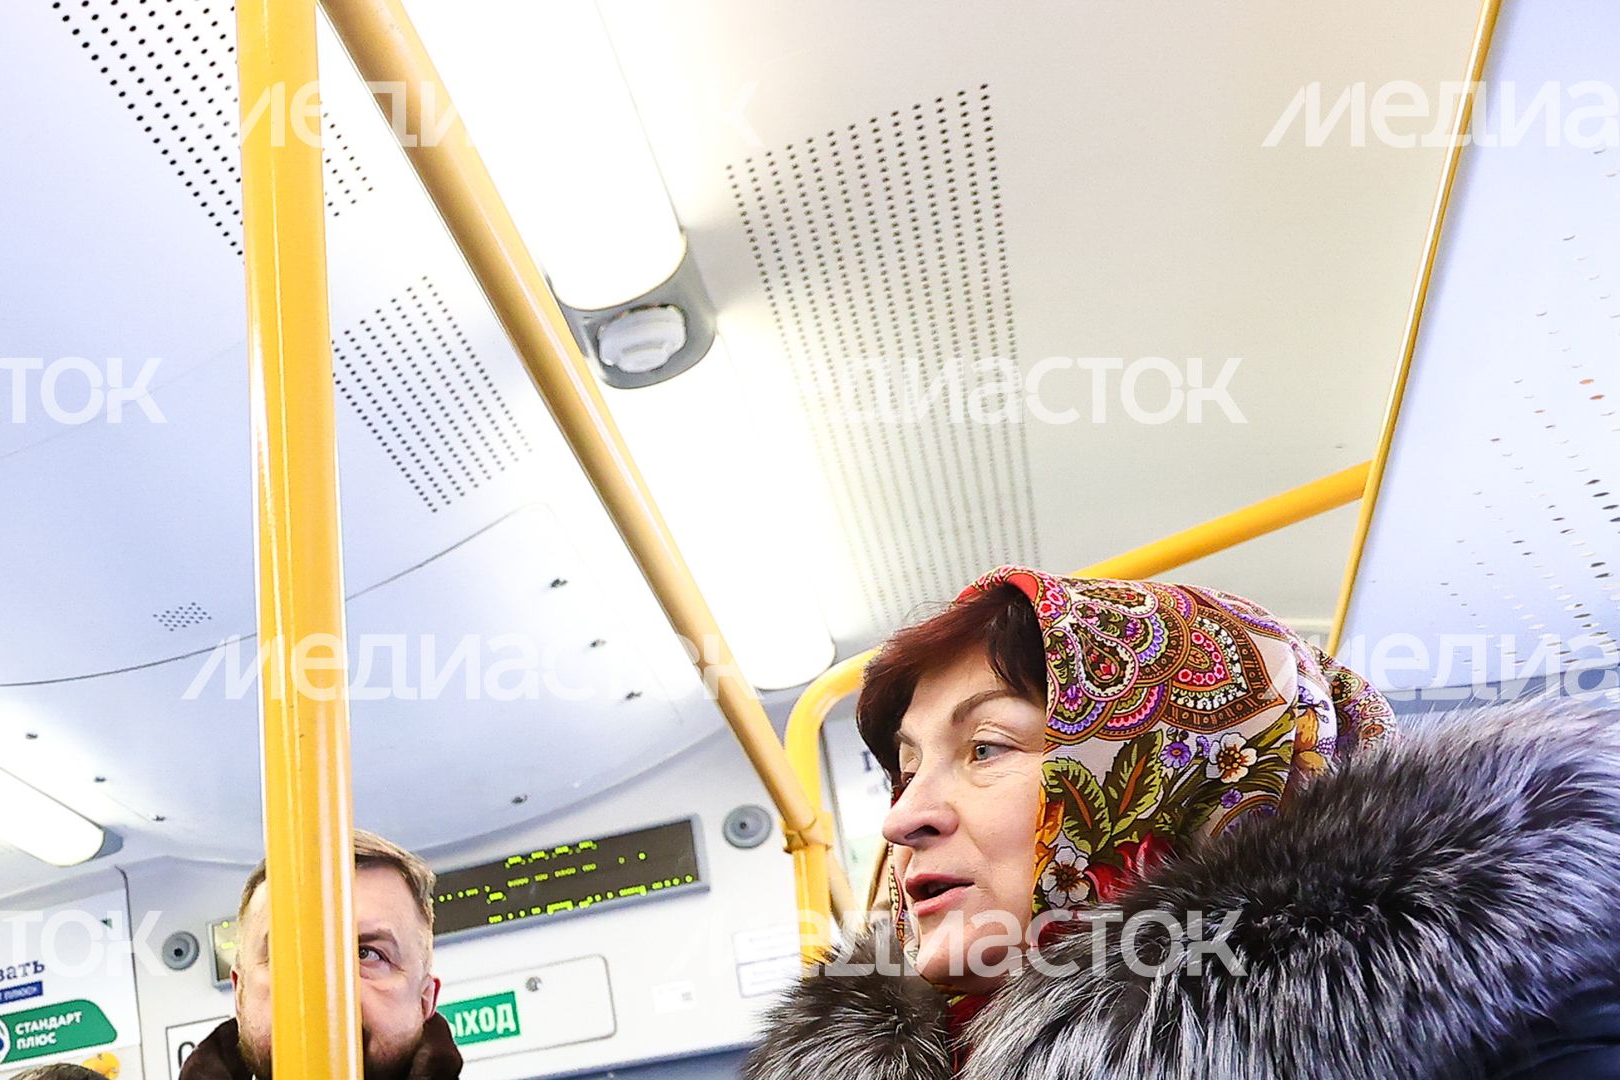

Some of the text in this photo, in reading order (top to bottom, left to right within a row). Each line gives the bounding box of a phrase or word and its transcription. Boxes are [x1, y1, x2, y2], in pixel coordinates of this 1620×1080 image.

[15, 1011, 83, 1035] СТАНДАРТ
[449, 1003, 517, 1037] ЫХОД
[17, 1033, 57, 1050] ПЛЮС
